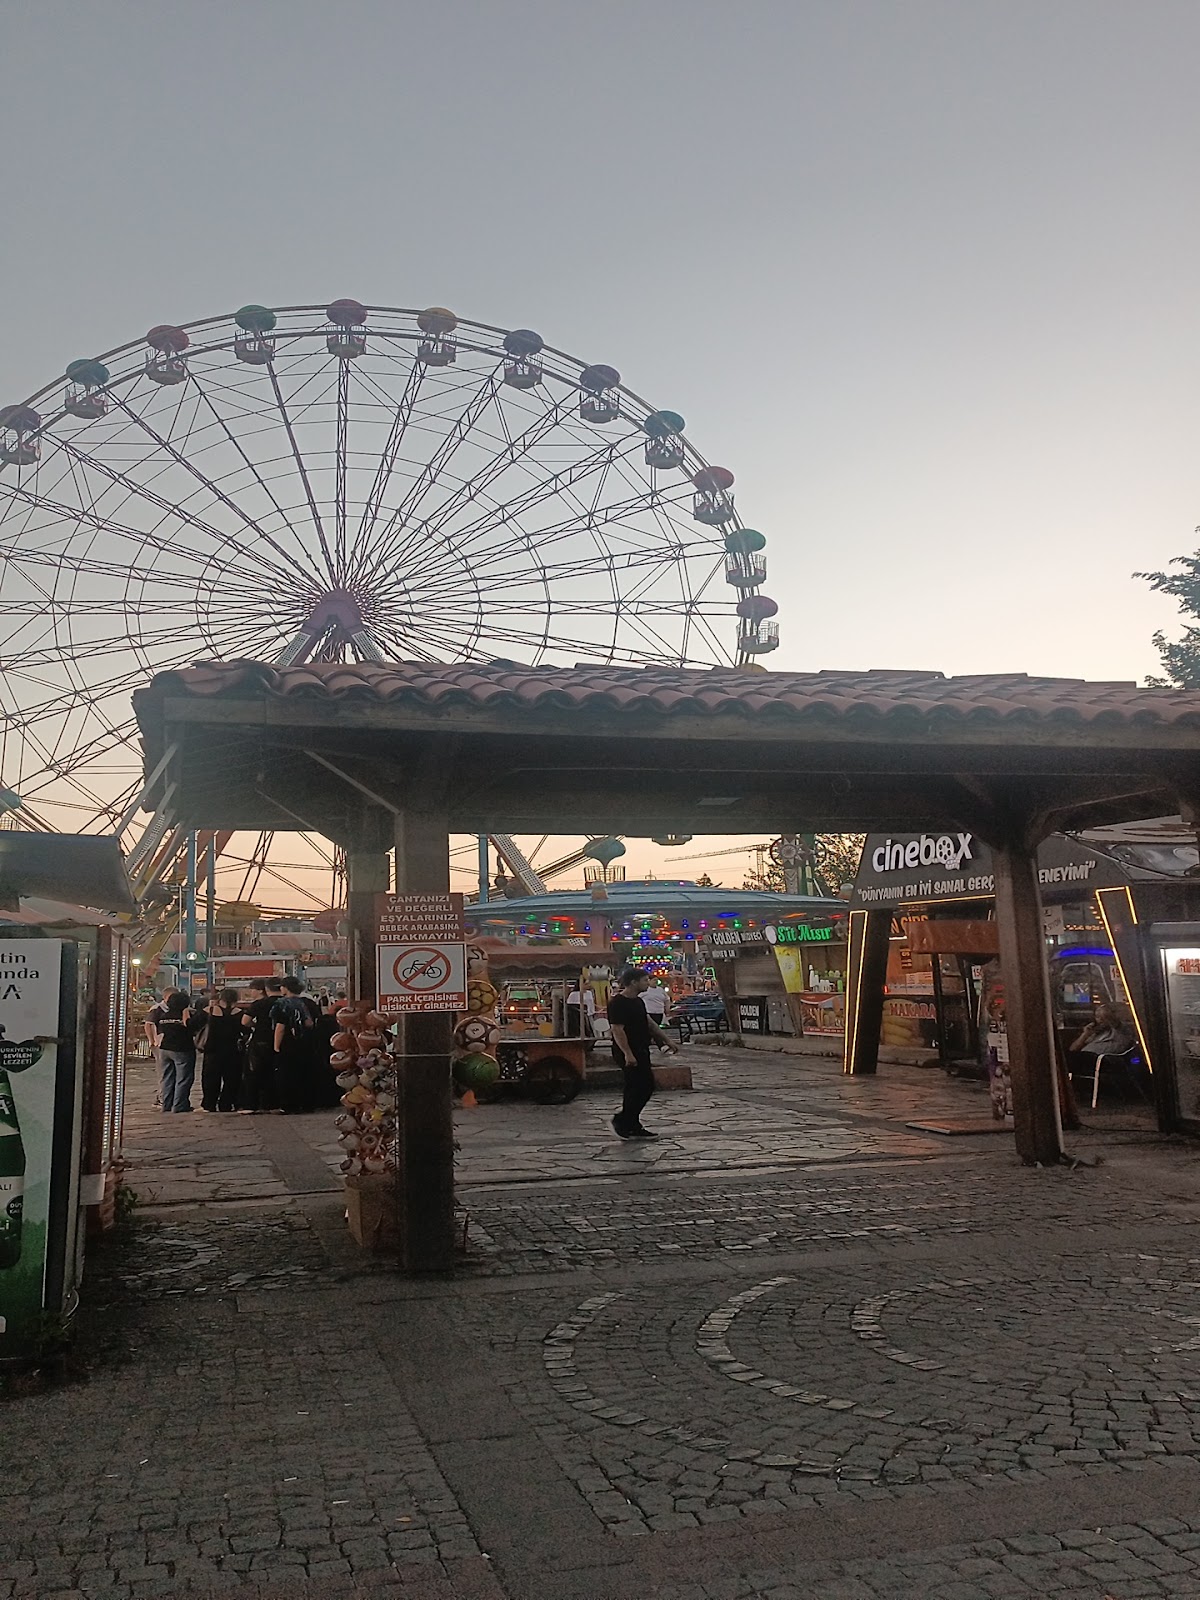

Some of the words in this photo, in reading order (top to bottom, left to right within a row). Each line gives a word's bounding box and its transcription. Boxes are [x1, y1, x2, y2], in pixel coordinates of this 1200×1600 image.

[905, 886, 917, 897] EN
[919, 879, 932, 896] İYİ
[933, 878, 965, 894] SANAL
[389, 895, 449, 904] ÇANTANIZI
[386, 905, 402, 913] VE
[405, 904, 453, 912] DEĞERLİ
[380, 914, 458, 923] EŞYALARINIZI
[379, 924, 408, 932] BEBEK
[410, 923, 460, 931] ARABASINA
[380, 932, 460, 941] BIRAKMAYIN.
[712, 930, 741, 945] GOLDEN
[387, 995, 412, 1003] PARK
[414, 993, 458, 1002] İÇERİSİNE
[381, 1003, 422, 1011] BİSİKLET
[424, 1001, 464, 1010] GİREMEZ
[740, 1004, 759, 1017] GOLDEN
[889, 1002, 936, 1018] MAKARA
